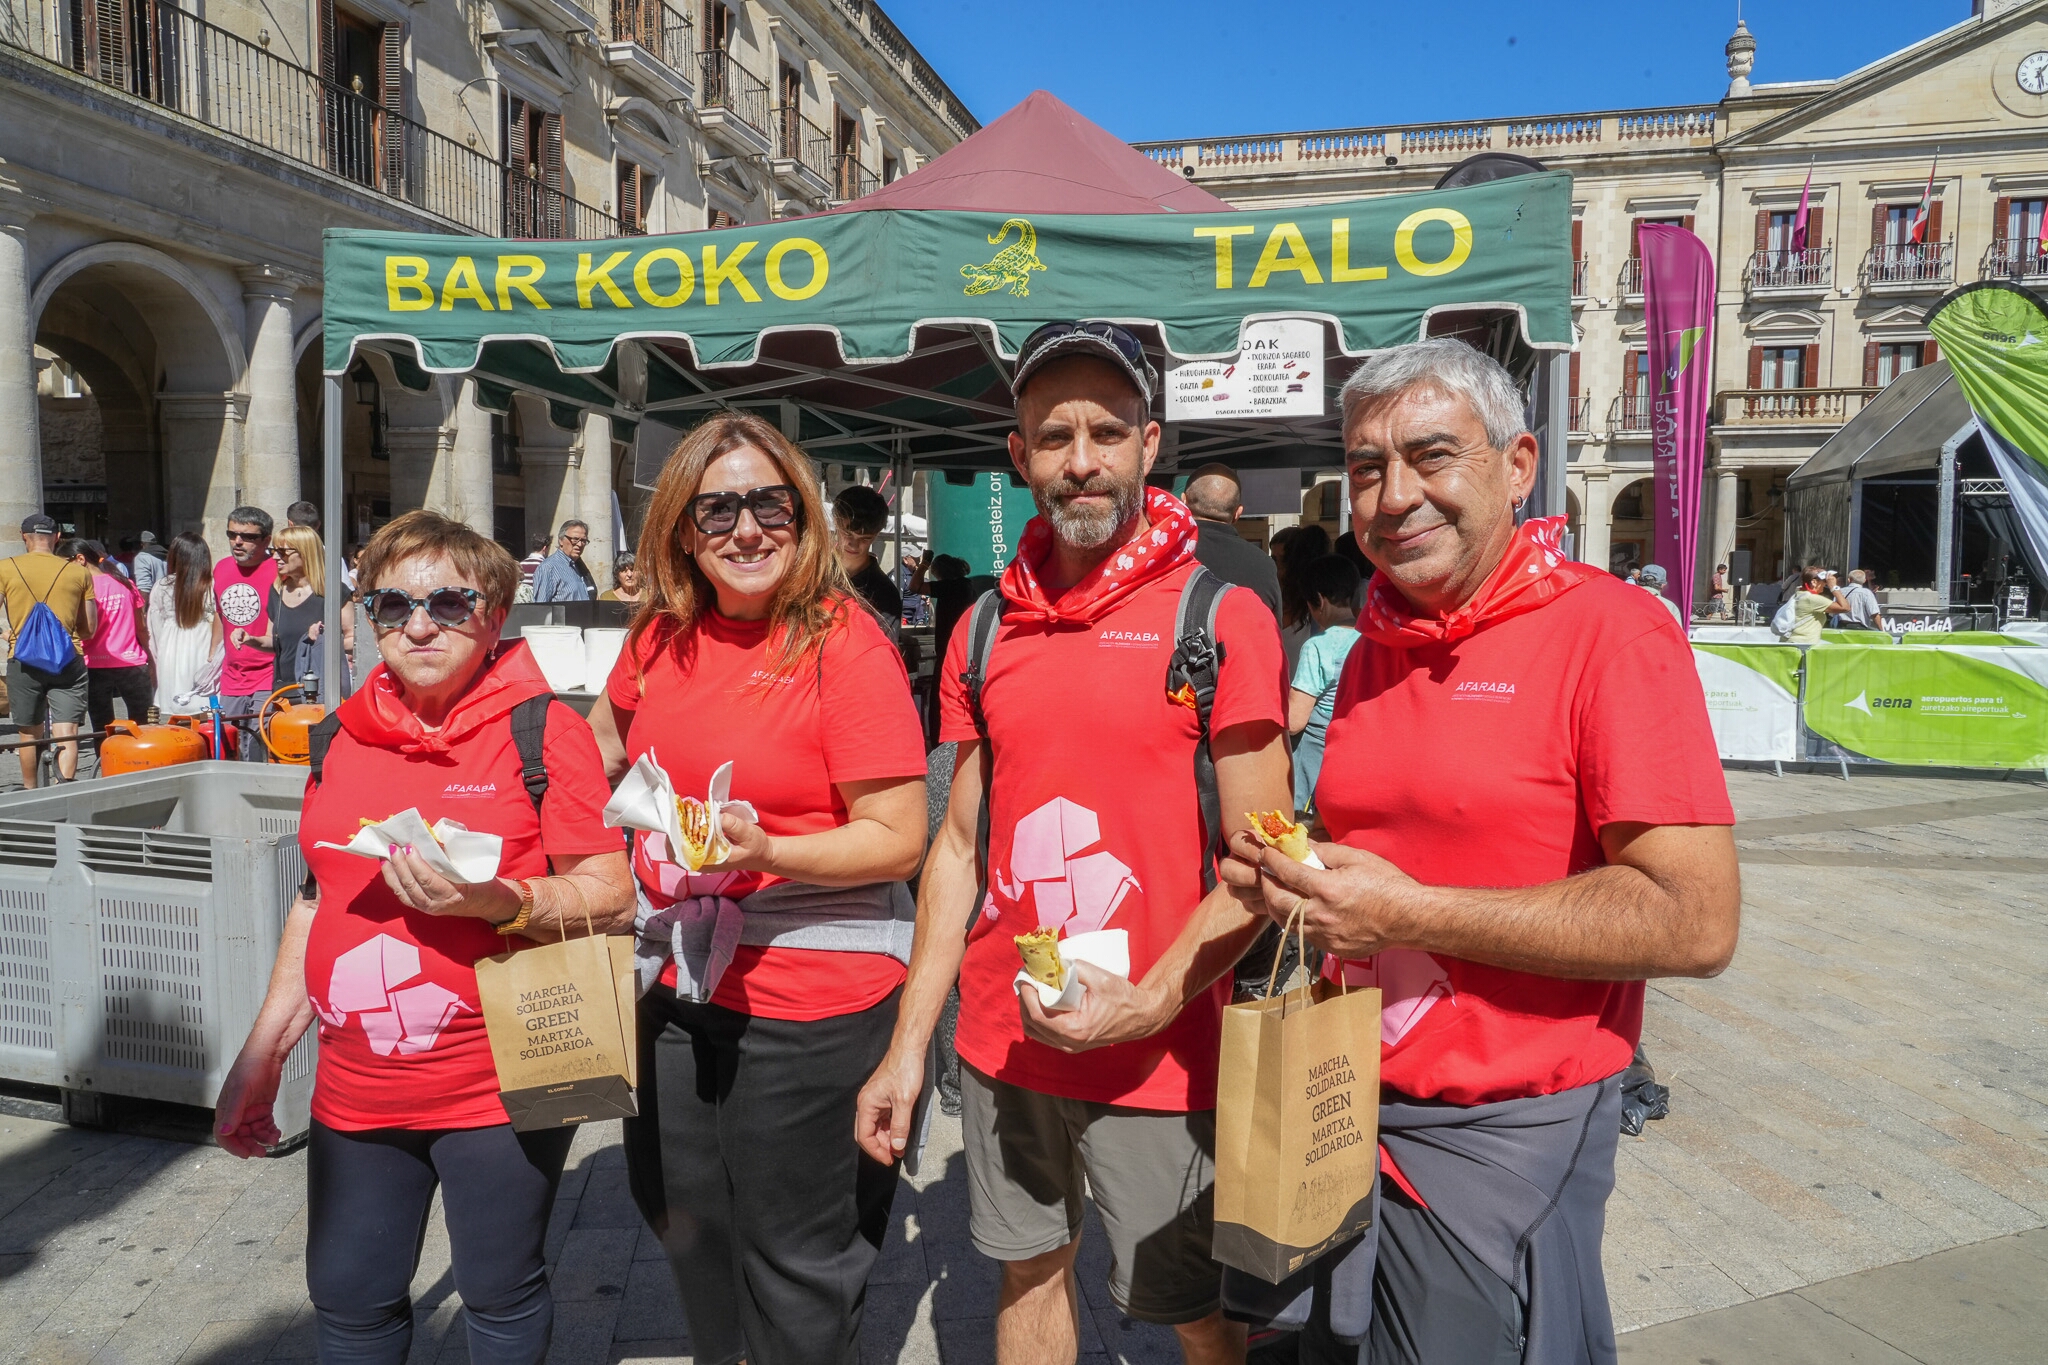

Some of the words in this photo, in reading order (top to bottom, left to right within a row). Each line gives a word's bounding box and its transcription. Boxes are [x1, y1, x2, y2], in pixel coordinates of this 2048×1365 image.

[1194, 208, 1473, 289] TALO
[385, 255, 551, 312] BAR
[577, 237, 829, 309] KOKO
[1252, 373, 1290, 382] TXOKOLATEA
[1180, 395, 1210, 403] SOLOMOA
[222, 584, 255, 599] RIP
[220, 596, 259, 610] CURL
[1100, 630, 1160, 642] AFARABA
[1456, 682, 1515, 694] AFARABA
[1872, 697, 1912, 708] aena
[1921, 696, 1972, 704] aeropuertos
[1996, 696, 2003, 704] ti
[1961, 705, 2009, 713] aireportuak
[444, 783, 496, 792] AFARABA
[516, 992, 584, 1016] SOLIDARIA
[519, 982, 577, 1004] MARCHA
[525, 1009, 580, 1032] GREEN
[528, 1025, 584, 1047] MARTXA
[520, 1036, 594, 1060] SOLIDARIOA
[1308, 1054, 1350, 1081] MARCHA
[1305, 1069, 1356, 1100] SOLIDARIA
[1312, 1091, 1352, 1123] GREEN
[1311, 1115, 1355, 1146] MARTXA
[1305, 1130, 1363, 1167] SOLIDARIOA
